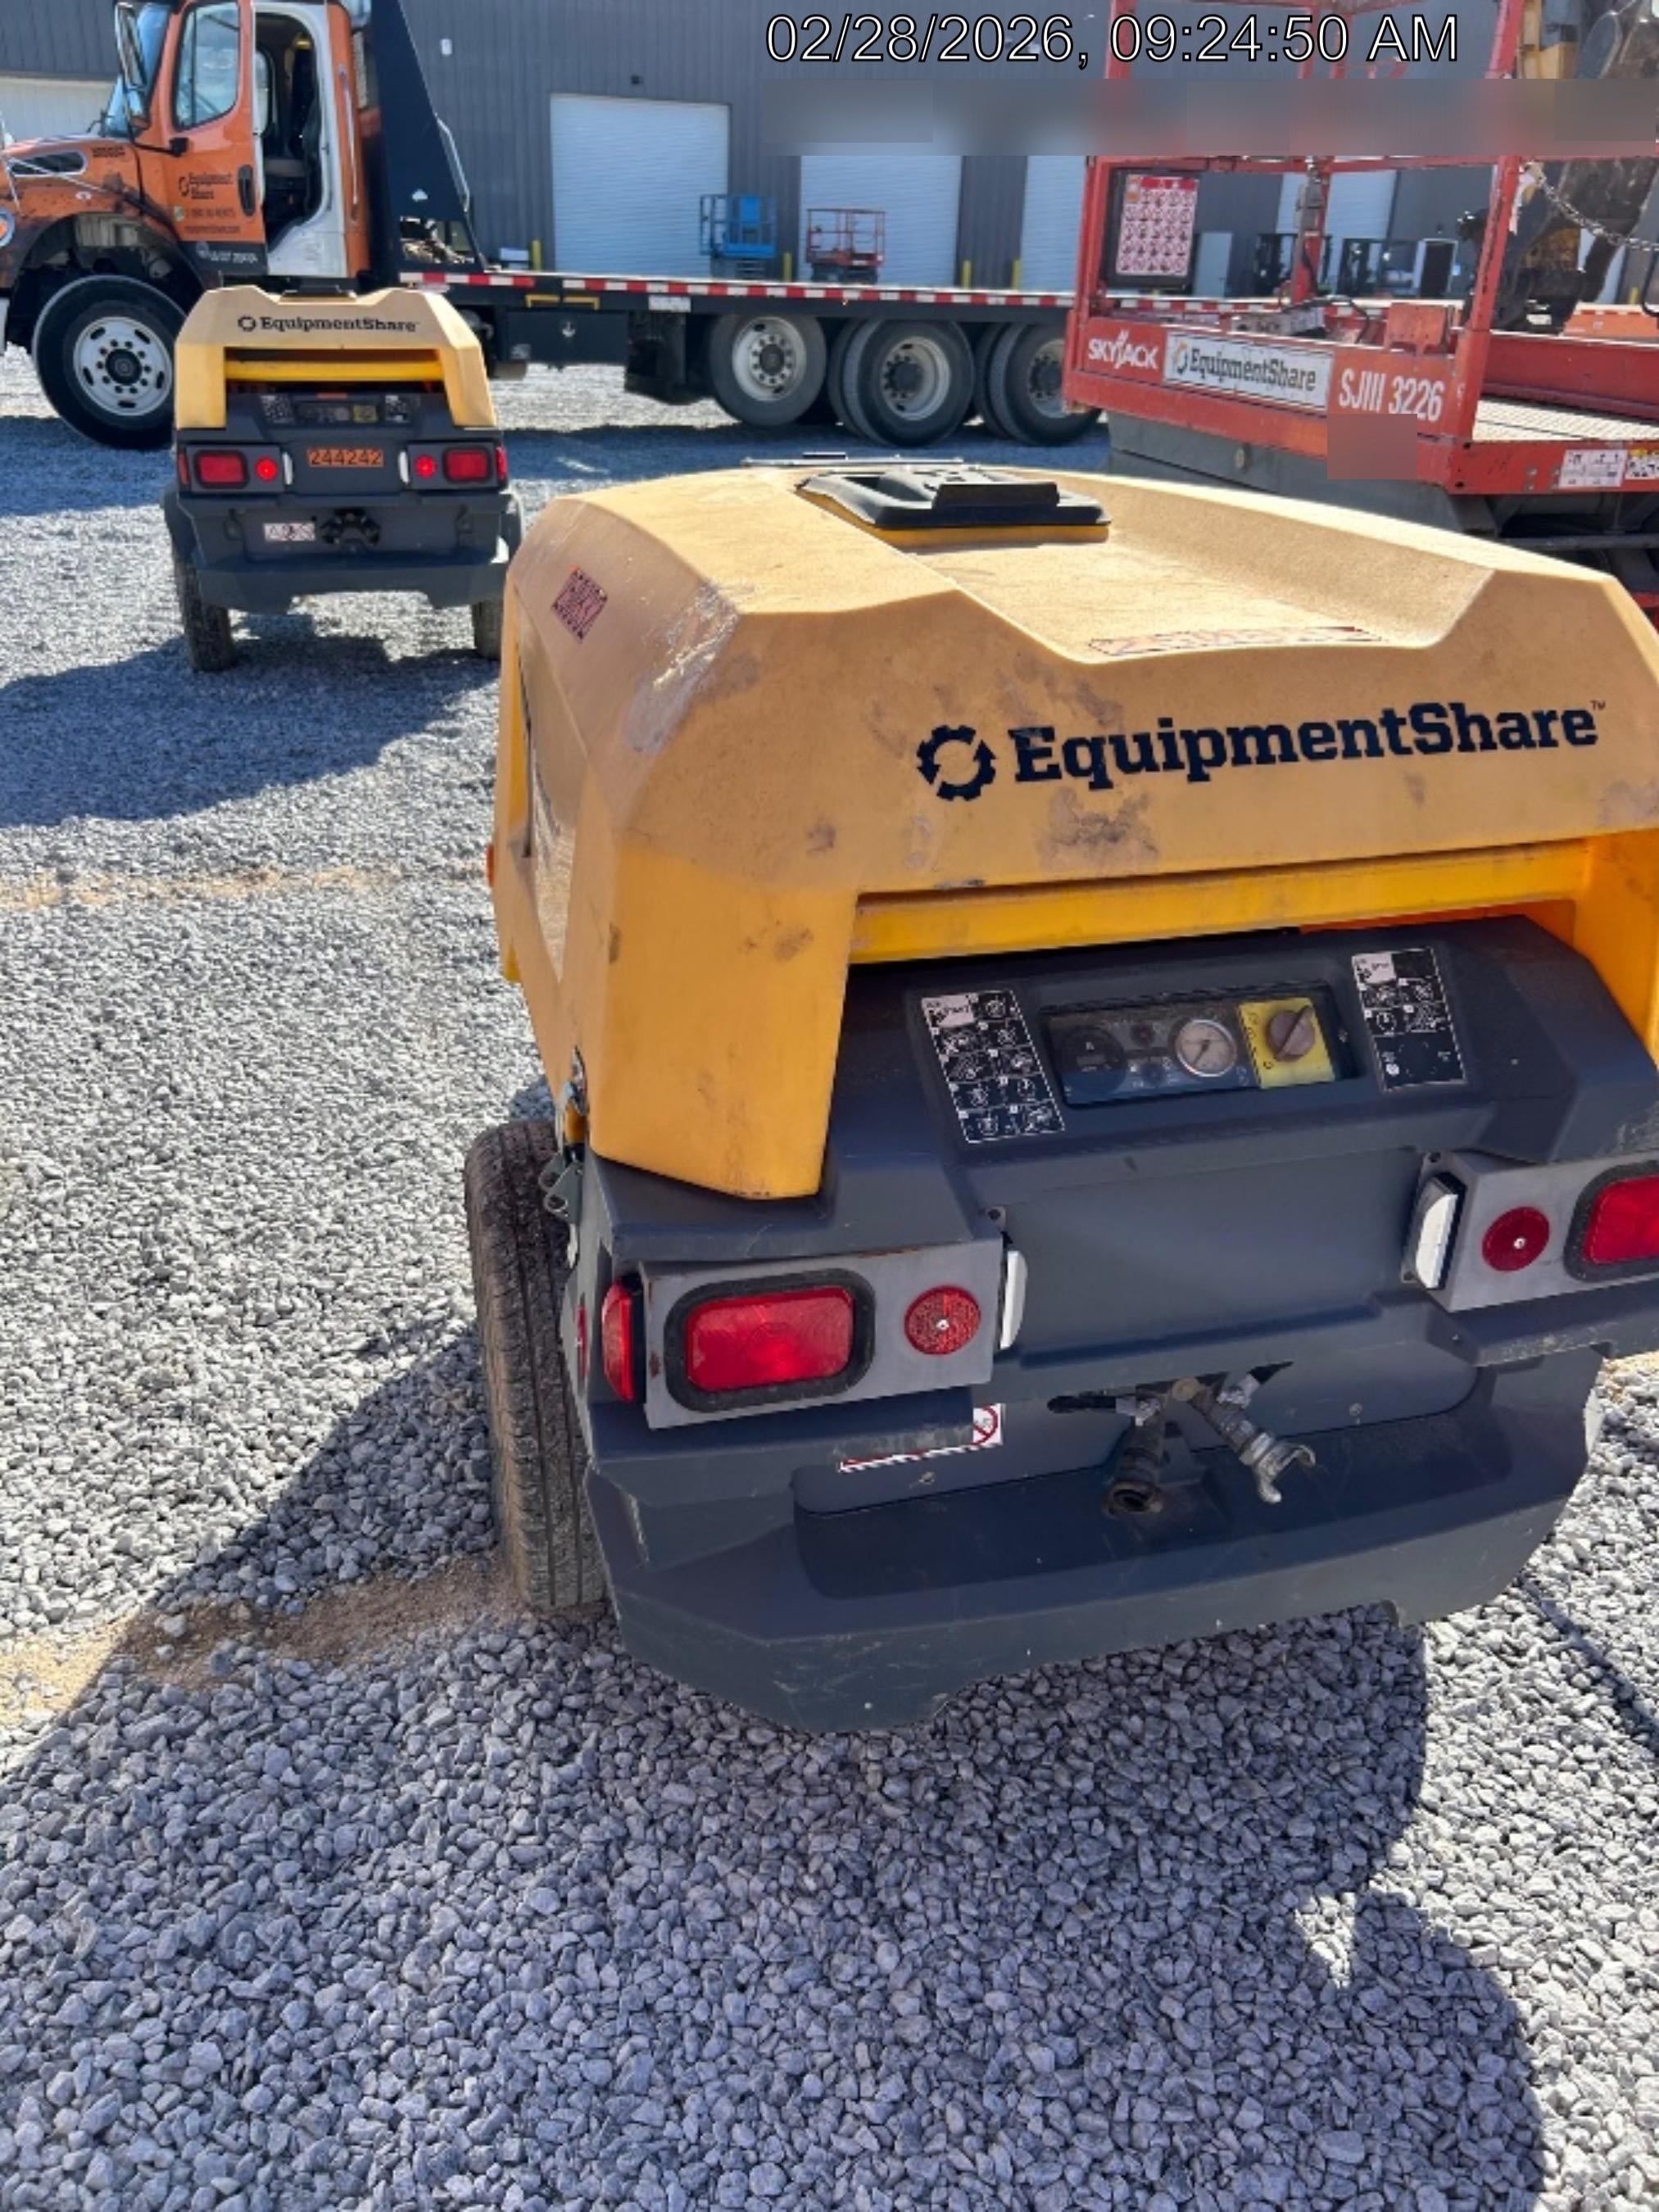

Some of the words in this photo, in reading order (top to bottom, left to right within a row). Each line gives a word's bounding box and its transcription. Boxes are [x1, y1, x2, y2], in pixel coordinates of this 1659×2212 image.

[261, 316, 416, 332] EquipmentShare
[1087, 329, 1159, 369] SKYJACK
[1190, 347, 1317, 392] EquipmentShare
[1389, 375, 1445, 422] 3226
[310, 448, 381, 466] 244242
